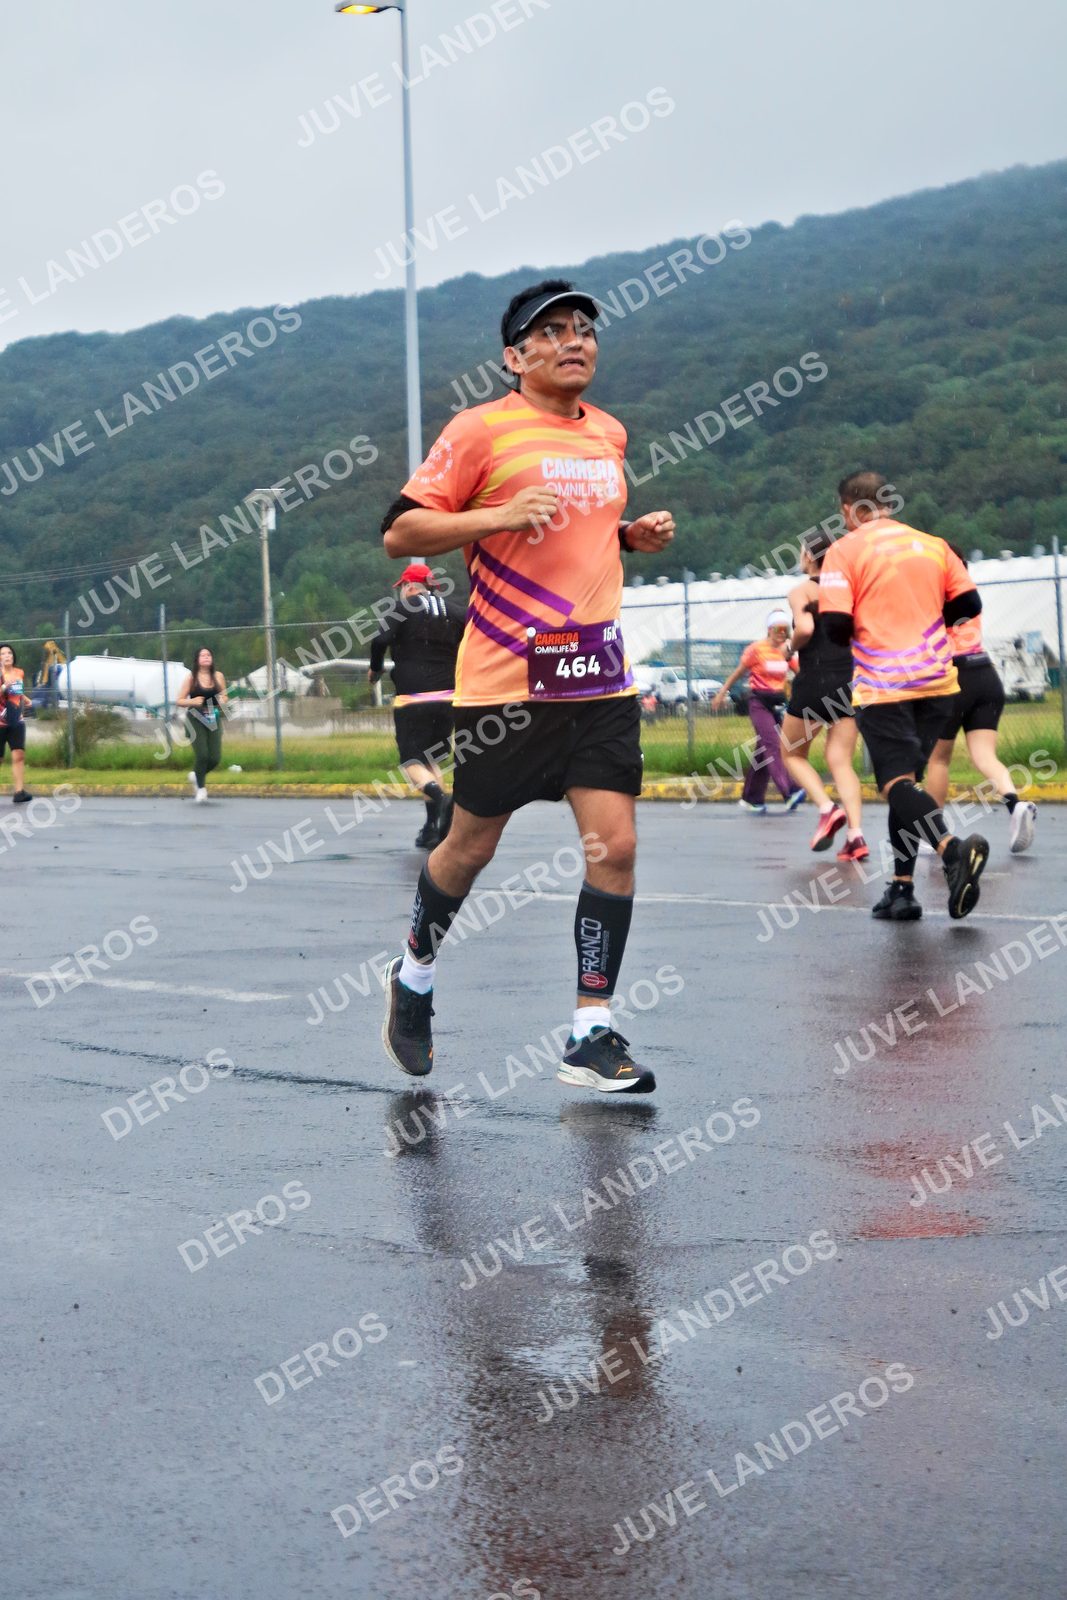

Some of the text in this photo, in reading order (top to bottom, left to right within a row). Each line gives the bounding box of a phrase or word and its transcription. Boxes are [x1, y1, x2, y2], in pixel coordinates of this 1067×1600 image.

[542, 457, 618, 480] CARRERA
[535, 632, 579, 646] CARRERA
[556, 655, 600, 678] 464
[580, 917, 602, 974] FRANCO
